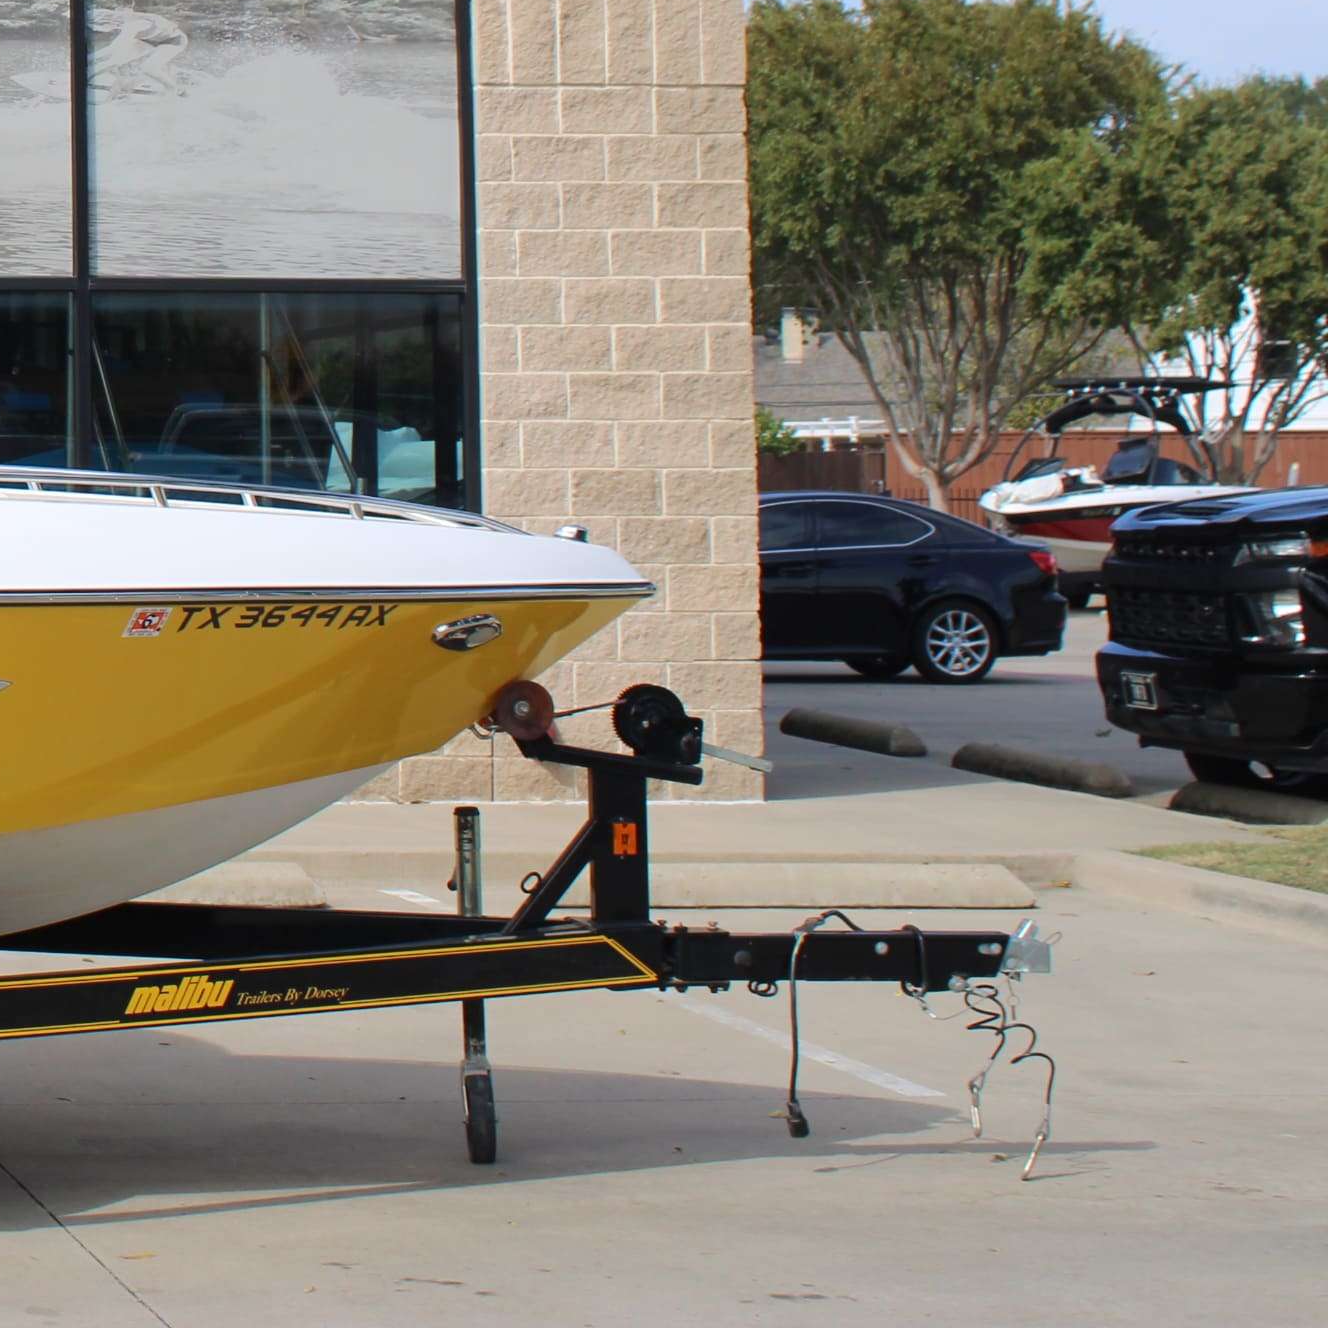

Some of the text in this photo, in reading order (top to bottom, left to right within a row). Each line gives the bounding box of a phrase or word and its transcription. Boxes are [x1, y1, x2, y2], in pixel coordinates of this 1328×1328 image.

[176, 606, 232, 632] TX
[237, 989, 282, 1005] Trailers
[285, 987, 302, 1006] By
[305, 984, 351, 1003] Dorsey
